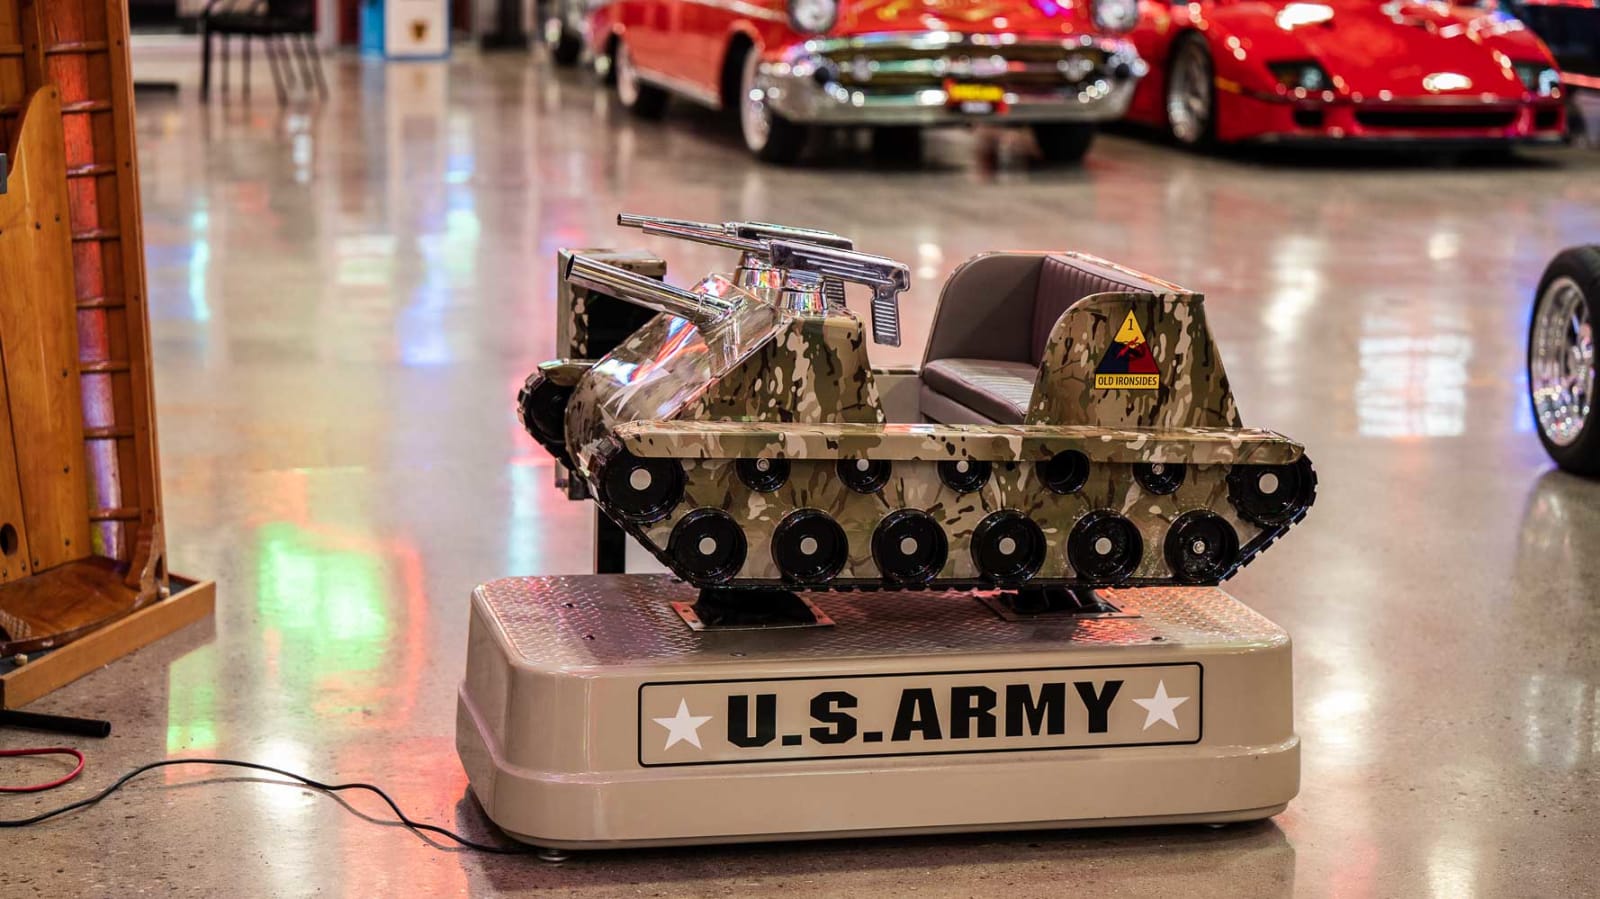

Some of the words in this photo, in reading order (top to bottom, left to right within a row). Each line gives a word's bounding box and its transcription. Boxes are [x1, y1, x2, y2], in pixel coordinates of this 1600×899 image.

[1128, 318, 1134, 330] 1
[1097, 376, 1114, 386] OLD
[1115, 376, 1157, 386] IRONSIDES
